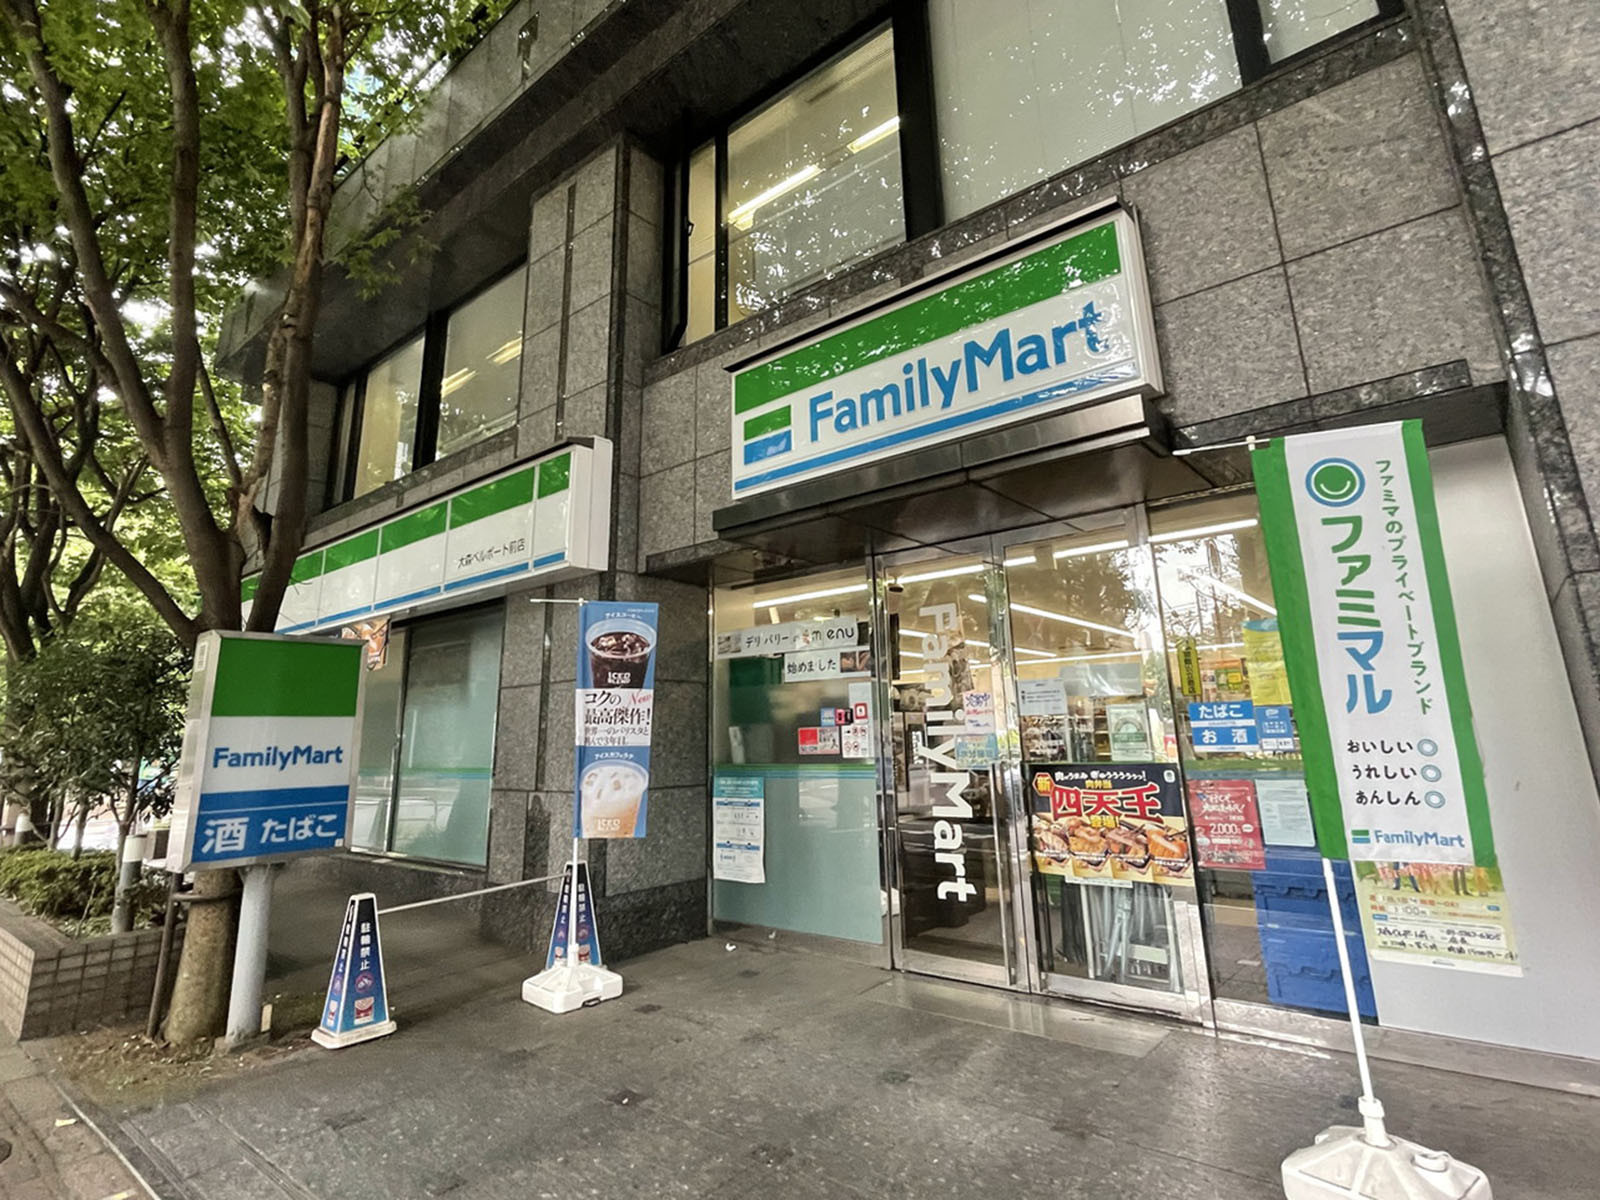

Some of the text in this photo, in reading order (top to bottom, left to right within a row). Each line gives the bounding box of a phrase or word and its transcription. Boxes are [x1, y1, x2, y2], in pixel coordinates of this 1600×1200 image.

[809, 301, 1108, 442] FamilyMart
[458, 538, 525, 568] 大森ベルポート前店
[1376, 460, 1433, 715] ファミマのプライベートブランド
[1321, 515, 1393, 714] ファミマル
[787, 659, 836, 674] 始めました
[585, 690, 621, 707] コクの
[1199, 704, 1243, 719] たばこ
[213, 745, 343, 771] FamilyMart
[919, 603, 977, 902] FamilyMart
[1347, 740, 1413, 754] おいしい
[1352, 764, 1417, 779] うれしい
[1052, 783, 1164, 823] 四天王
[1356, 790, 1421, 805] あんしん
[201, 814, 338, 853] 酒 たばこ
[1374, 830, 1465, 848] FamilyMart
